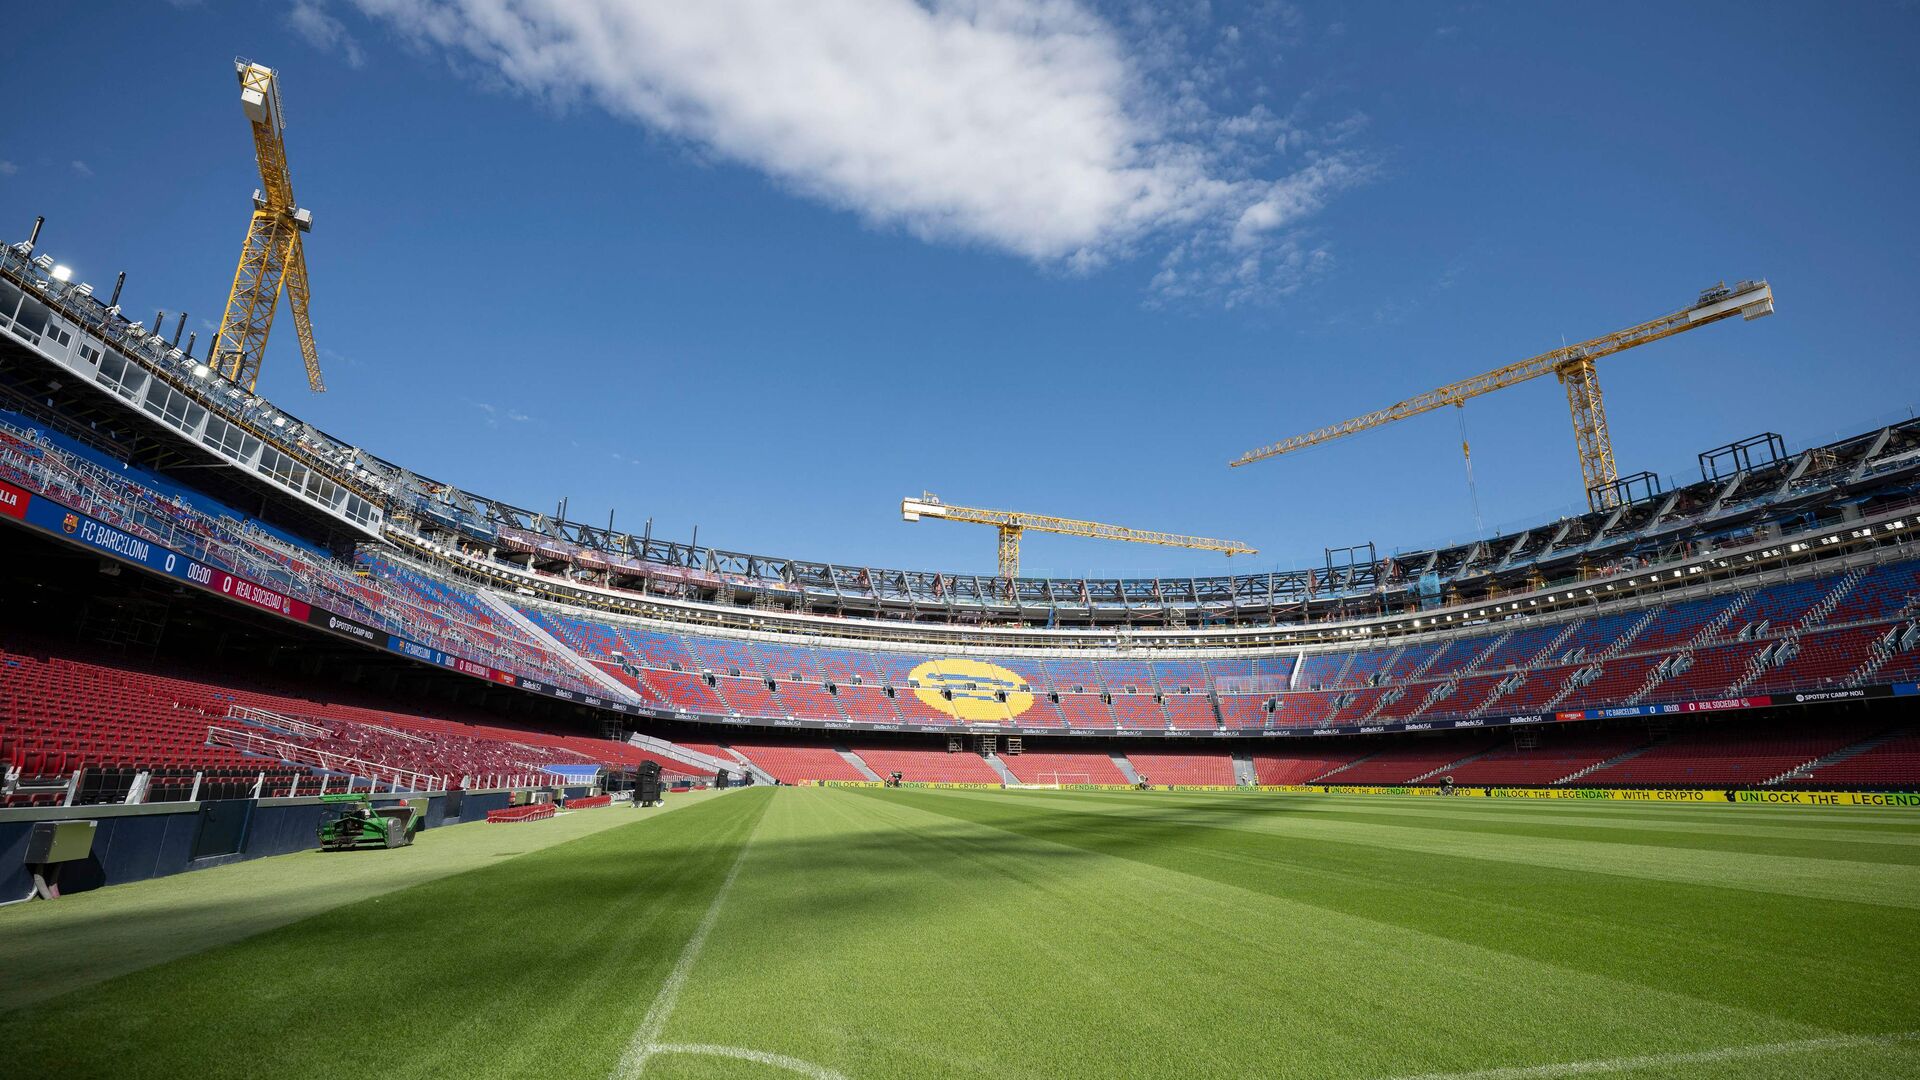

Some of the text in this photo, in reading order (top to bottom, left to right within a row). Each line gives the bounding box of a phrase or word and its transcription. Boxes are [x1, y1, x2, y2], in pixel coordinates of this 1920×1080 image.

[81, 520, 149, 562] FC BARCELONA
[165, 554, 176, 572] 0
[187, 562, 211, 584] 00:00
[223, 576, 232, 593] 0
[235, 581, 283, 610] REAL SOCIEDAD
[336, 620, 374, 640] SPOTIFY CAMP NOU
[1650, 706, 1656, 714] 0
[1663, 704, 1680, 713] 00:00
[1689, 703, 1695, 711] 0
[1699, 699, 1740, 710] REAL SOCIEDAD
[1605, 707, 1640, 717] FC BARCELONA
[1510, 715, 1543, 724] BioTechUSA
[1493, 789, 1704, 801] UNLOCK THE LEGENDARY WITH CRYPTO
[1740, 791, 1801, 803] UNLOCK
[1807, 794, 1841, 805] THE
